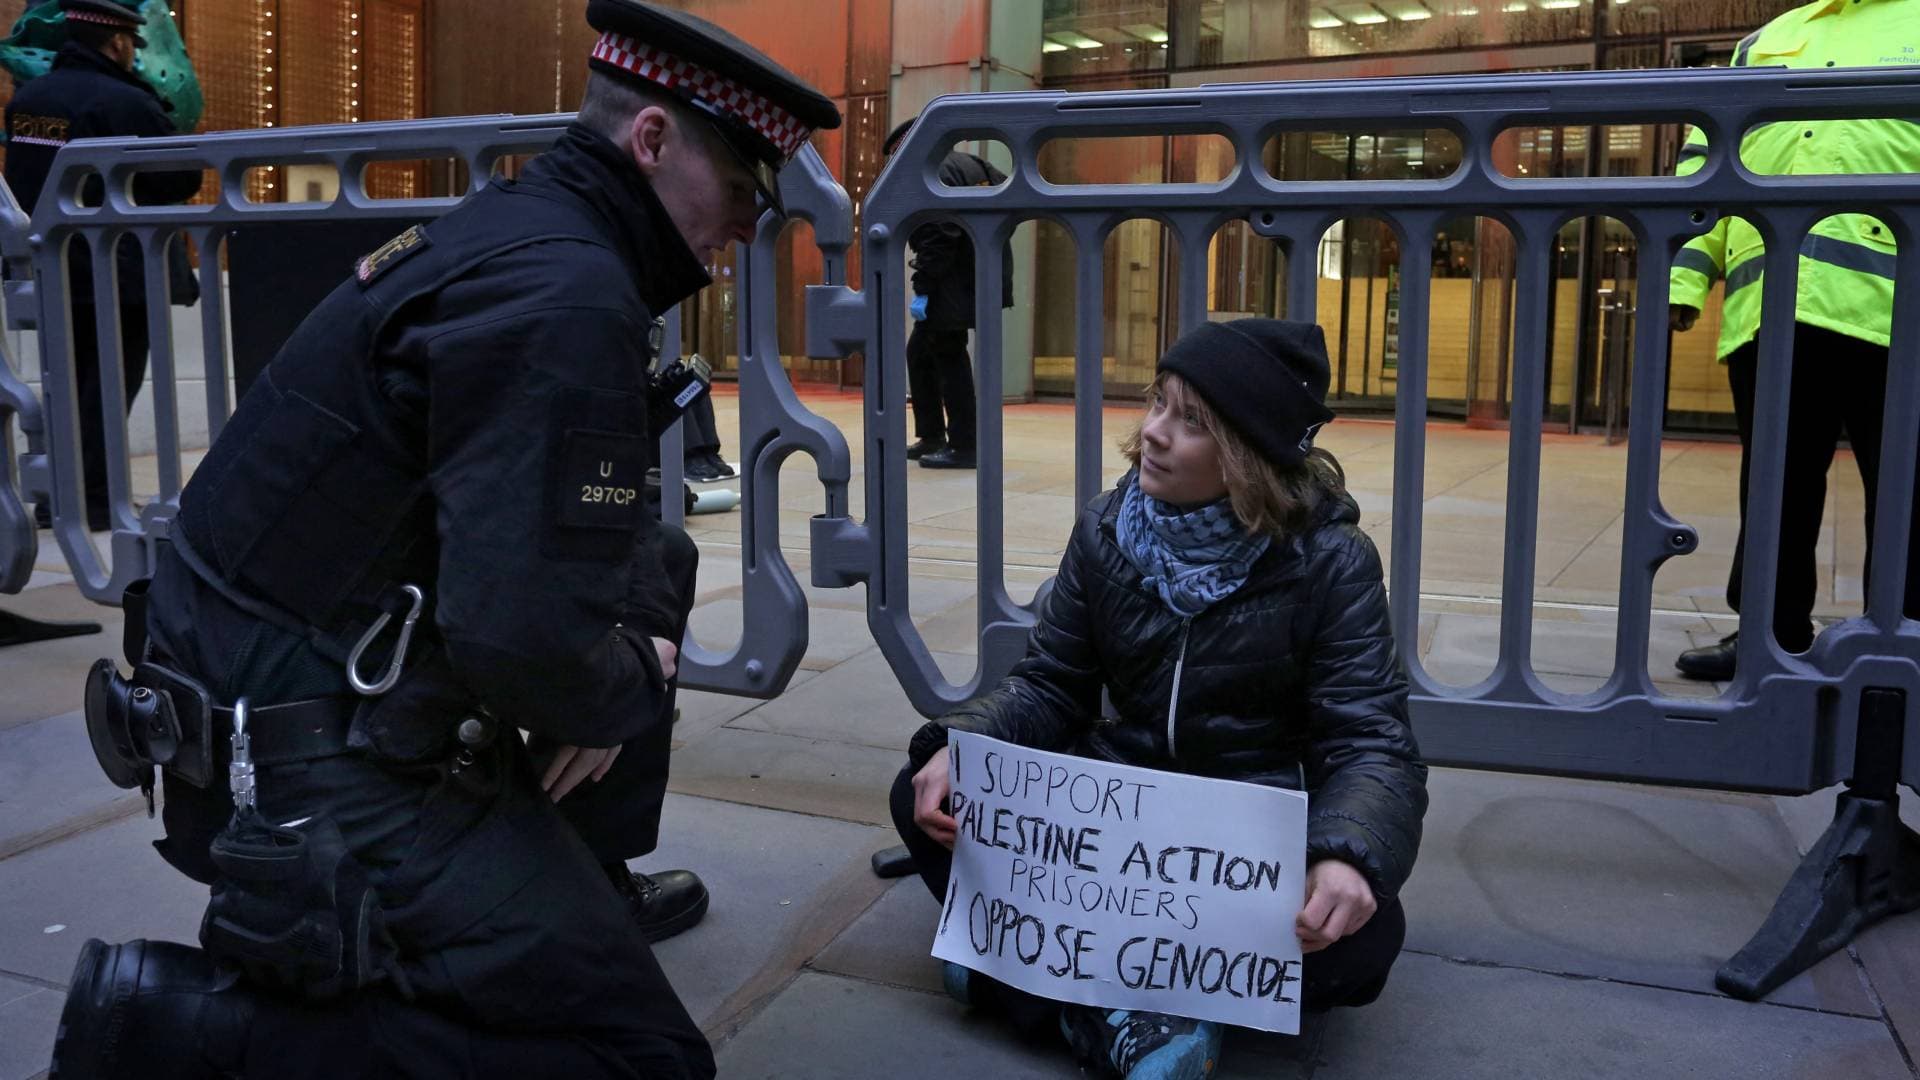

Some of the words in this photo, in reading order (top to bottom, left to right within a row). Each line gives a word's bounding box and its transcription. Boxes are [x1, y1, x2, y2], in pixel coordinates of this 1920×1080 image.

[13, 119, 69, 140] POLICE
[581, 485, 636, 505] 297CP
[600, 461, 613, 477] U
[980, 751, 1157, 822] SUPPORT
[950, 790, 1101, 873] PALESTINE
[1120, 840, 1282, 891] ACTION
[1010, 858, 1201, 930] PRISONERS
[969, 891, 1097, 980] OPPOSE
[1116, 936, 1302, 1003] GENOCIDE
